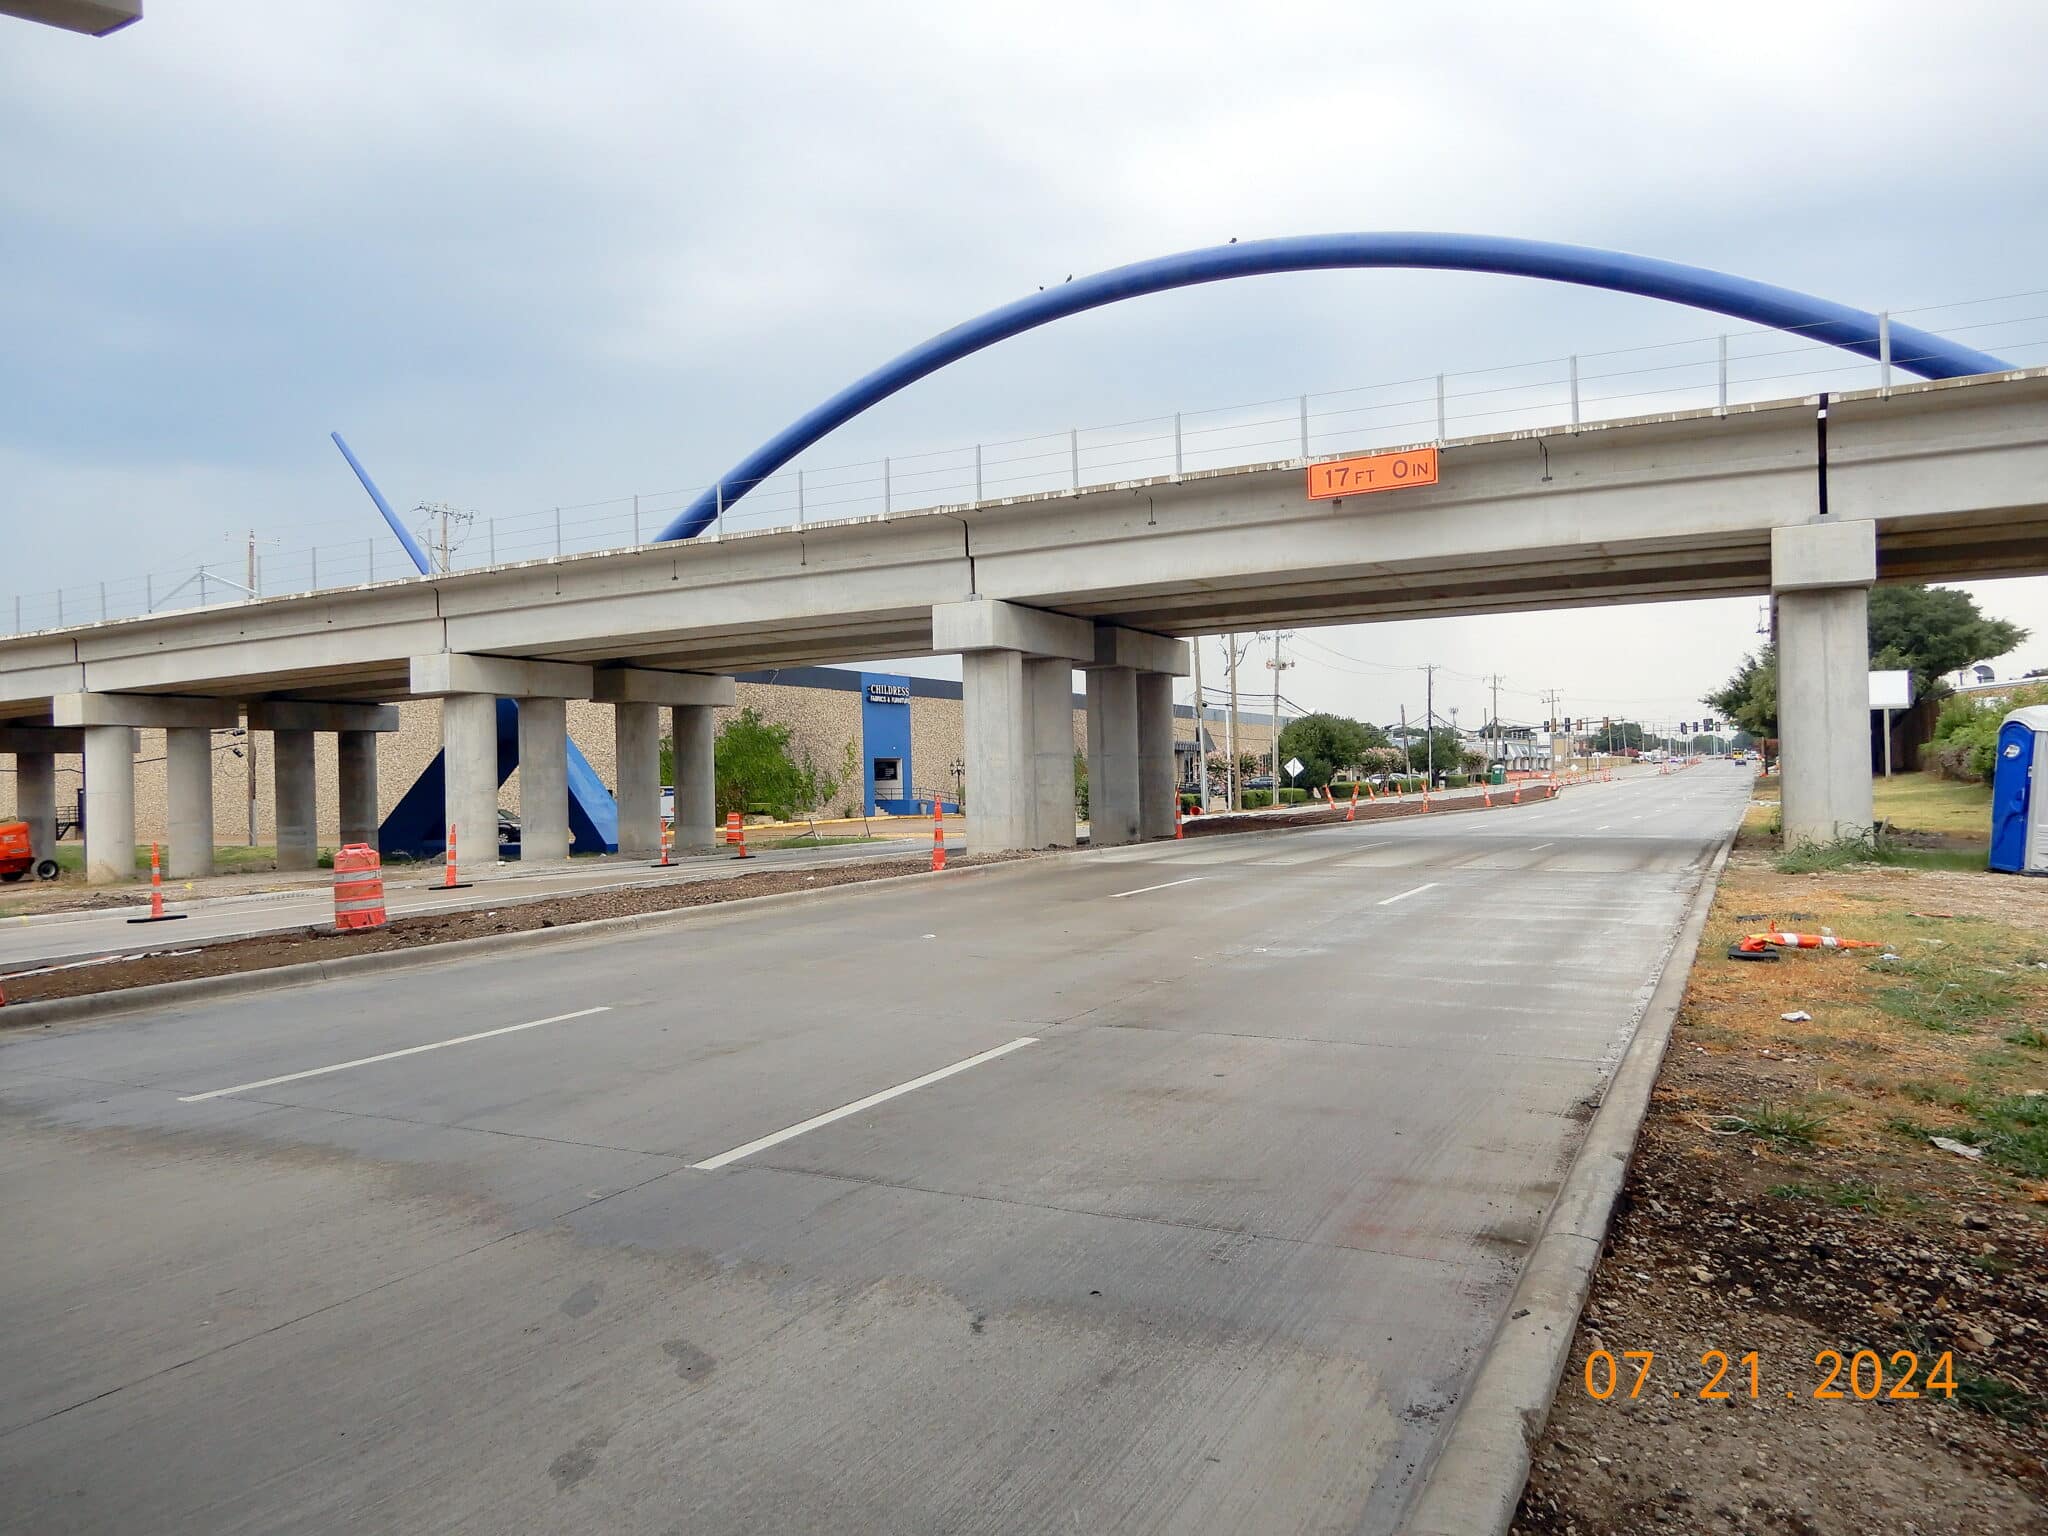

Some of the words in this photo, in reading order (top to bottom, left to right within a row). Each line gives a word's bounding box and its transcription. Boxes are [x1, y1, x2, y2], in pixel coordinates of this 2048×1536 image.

[1325, 467, 1349, 488] 17
[1355, 469, 1375, 485] FT
[1412, 462, 1429, 477] IN
[870, 684, 910, 697] CHILDRESS
